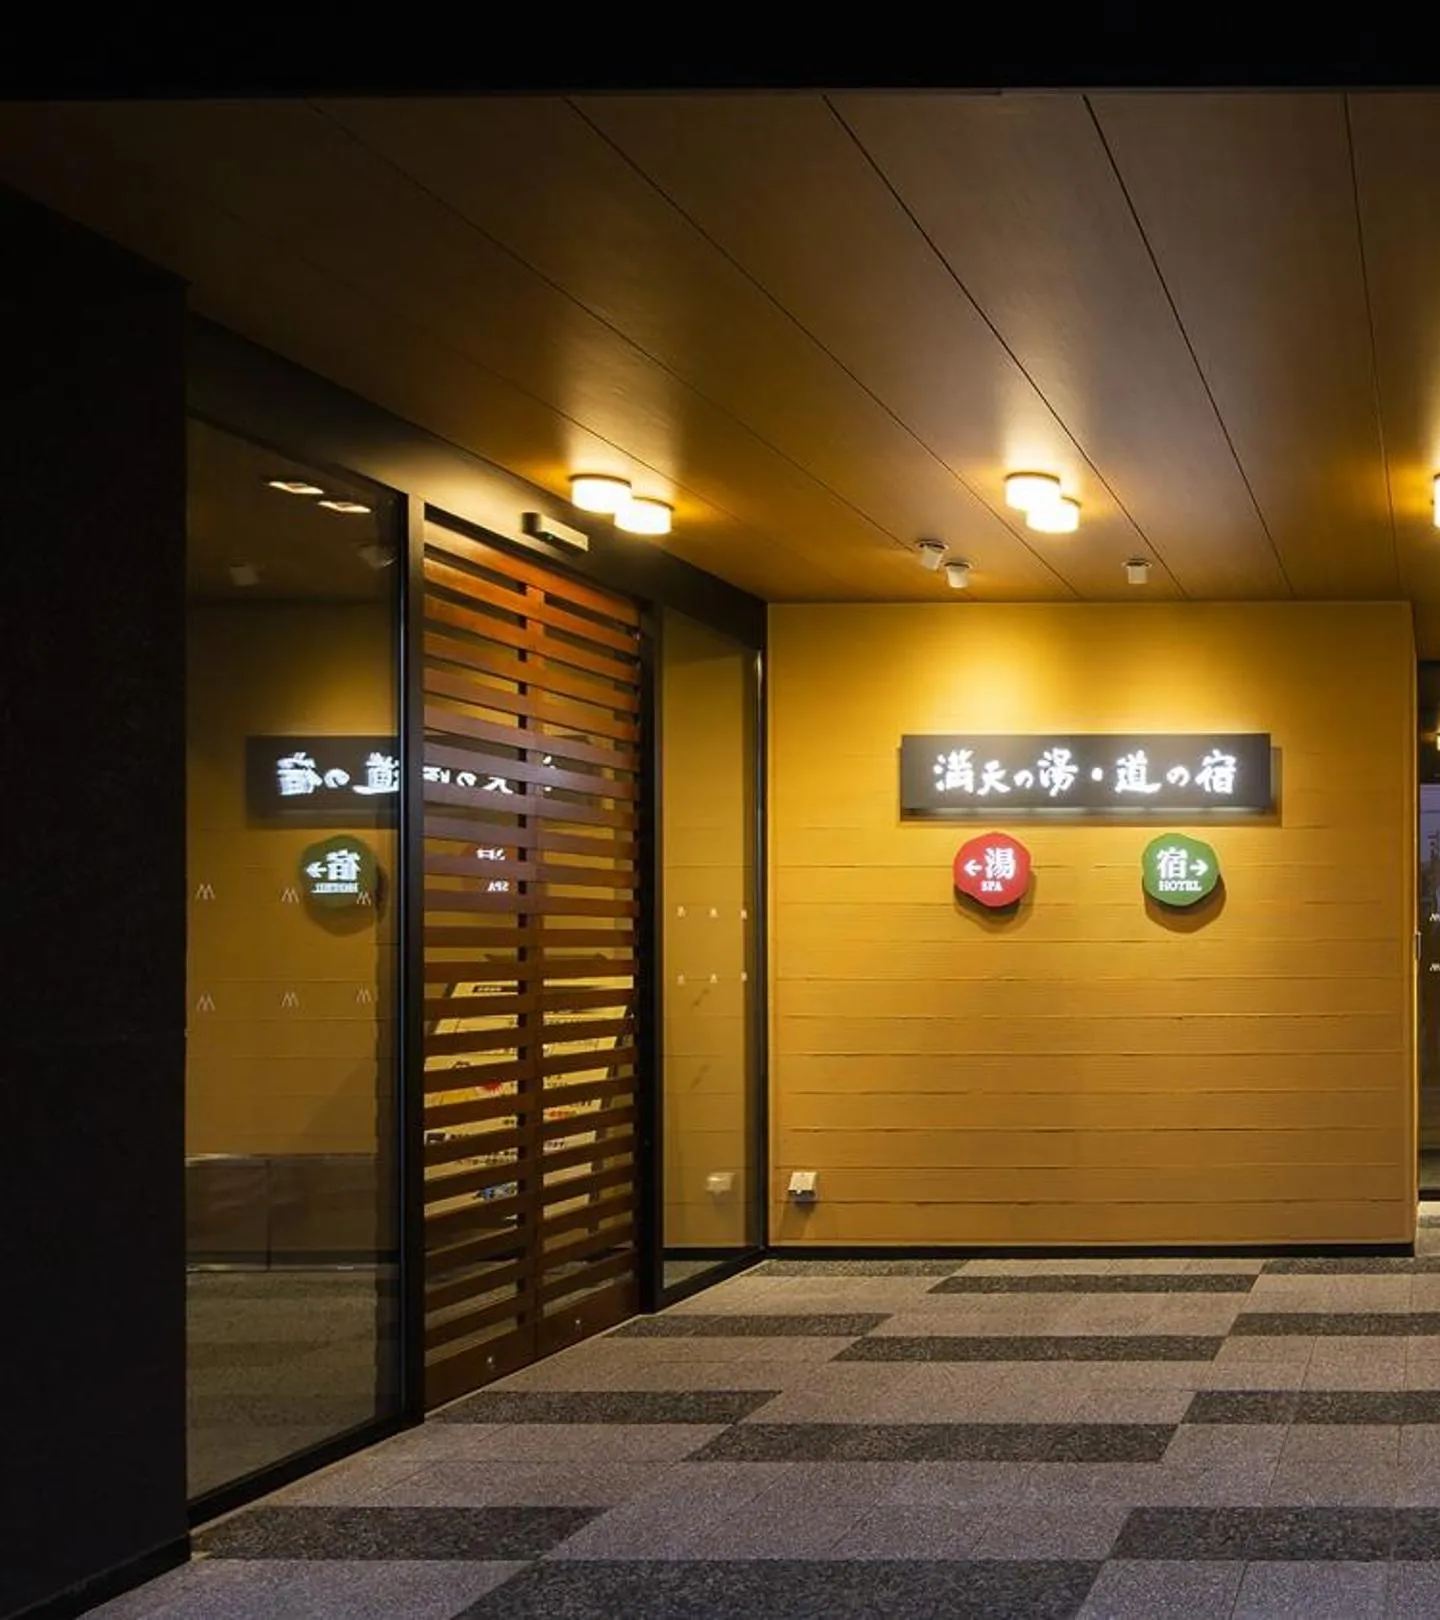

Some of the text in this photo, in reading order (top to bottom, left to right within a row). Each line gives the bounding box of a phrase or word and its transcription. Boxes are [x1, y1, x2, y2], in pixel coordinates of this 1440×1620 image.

[984, 847, 1016, 880] 湯
[1156, 846, 1188, 880] 宿
[981, 880, 1003, 892] SPA
[1158, 880, 1203, 892] HOTEL
